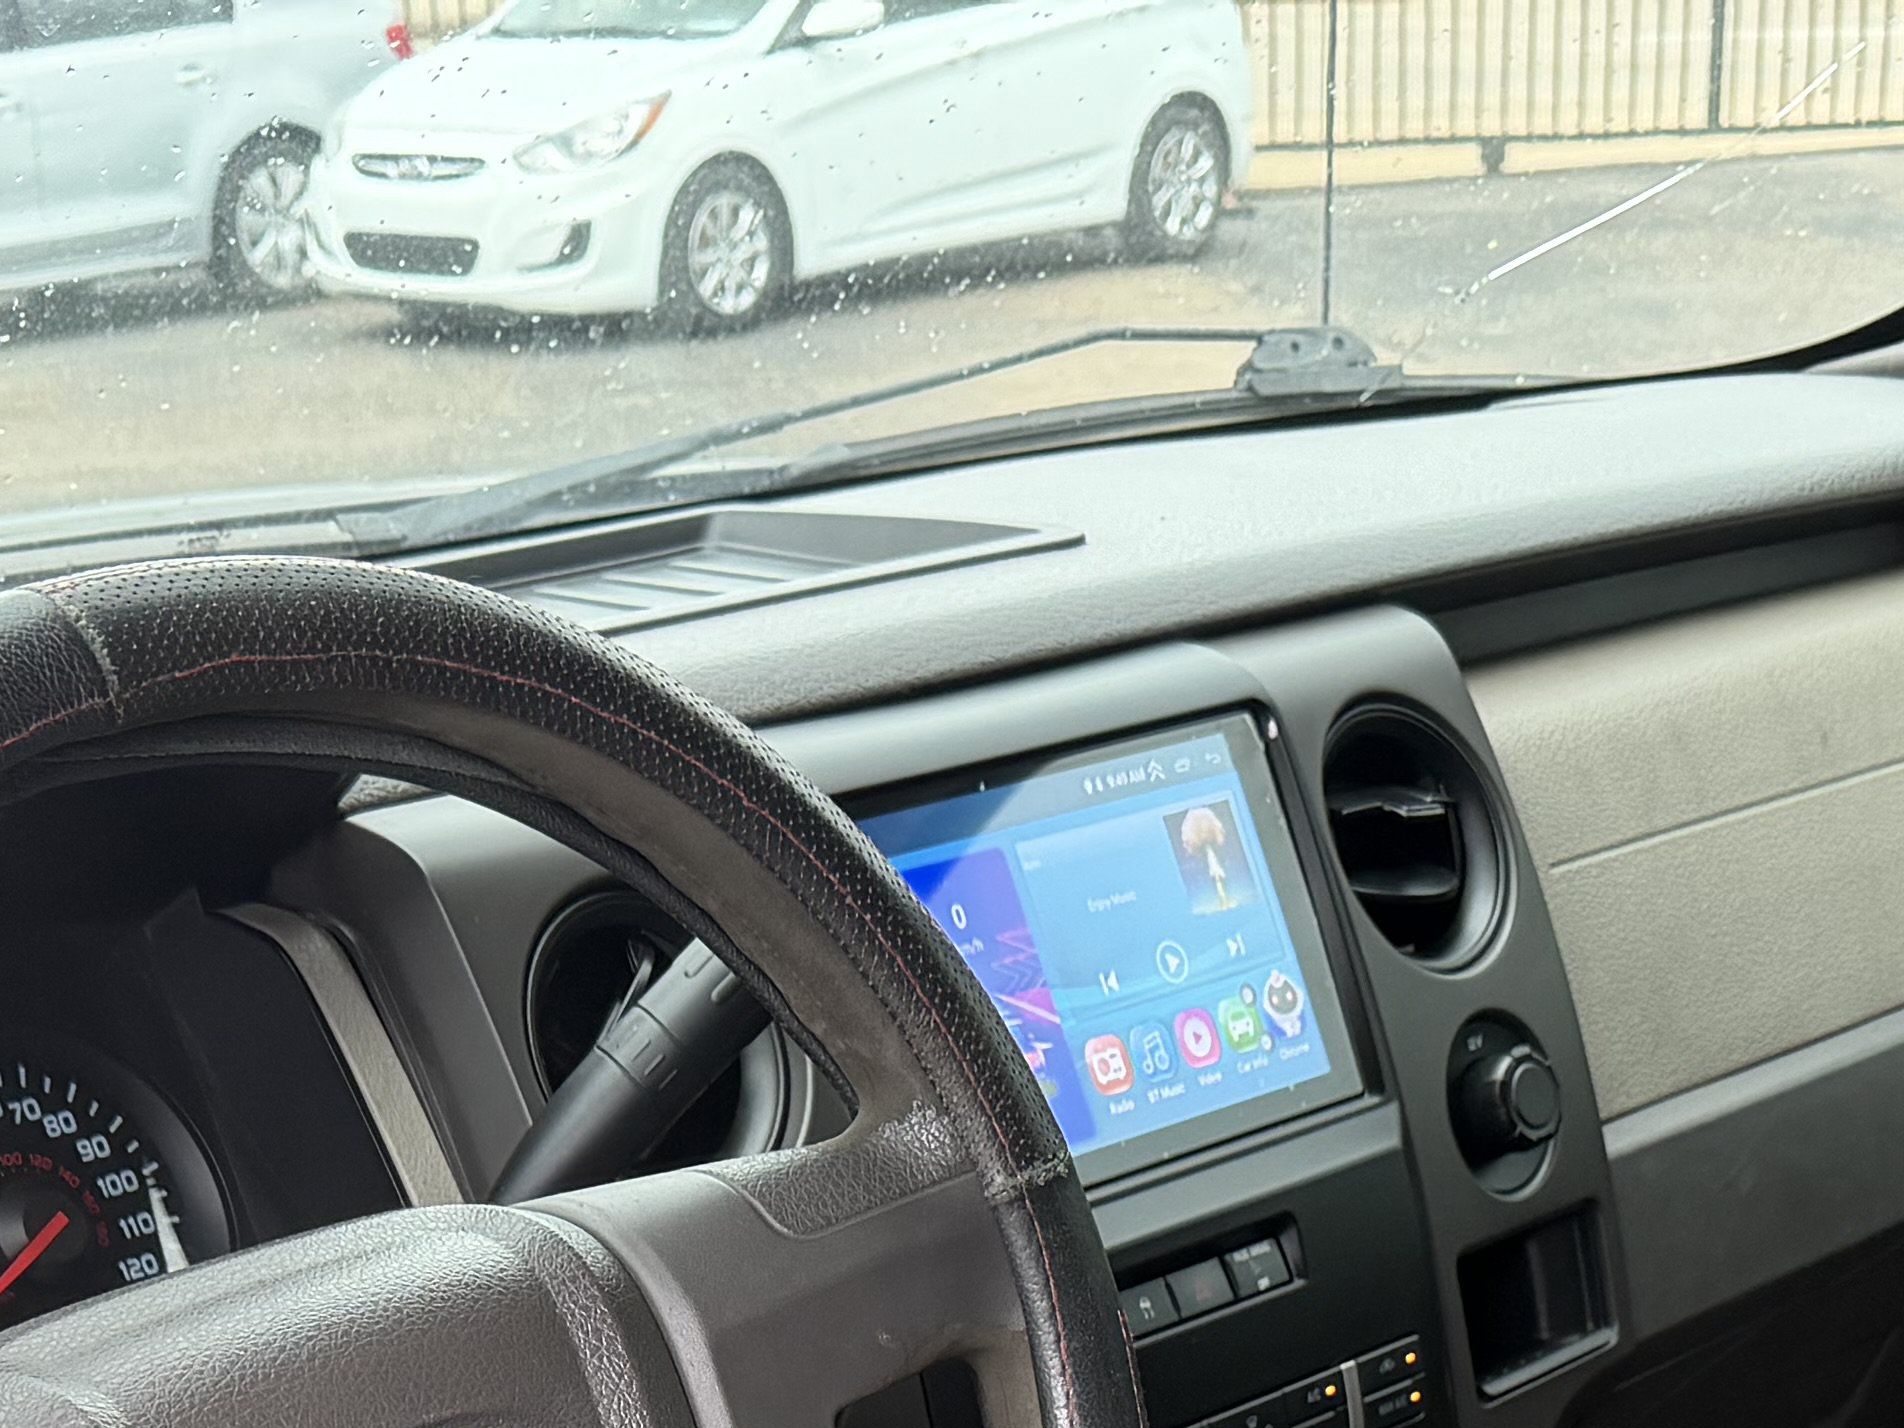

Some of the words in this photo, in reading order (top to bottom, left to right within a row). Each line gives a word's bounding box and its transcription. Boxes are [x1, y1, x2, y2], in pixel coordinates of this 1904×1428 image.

[951, 903, 967, 930] 0
[8, 1096, 42, 1125] 70
[42, 1110, 78, 1138] 80
[29, 1153, 53, 1171] 120
[75, 1134, 111, 1163] 90
[97, 1169, 139, 1199] 100
[118, 1211, 156, 1240] 110
[118, 1252, 160, 1282] 120
